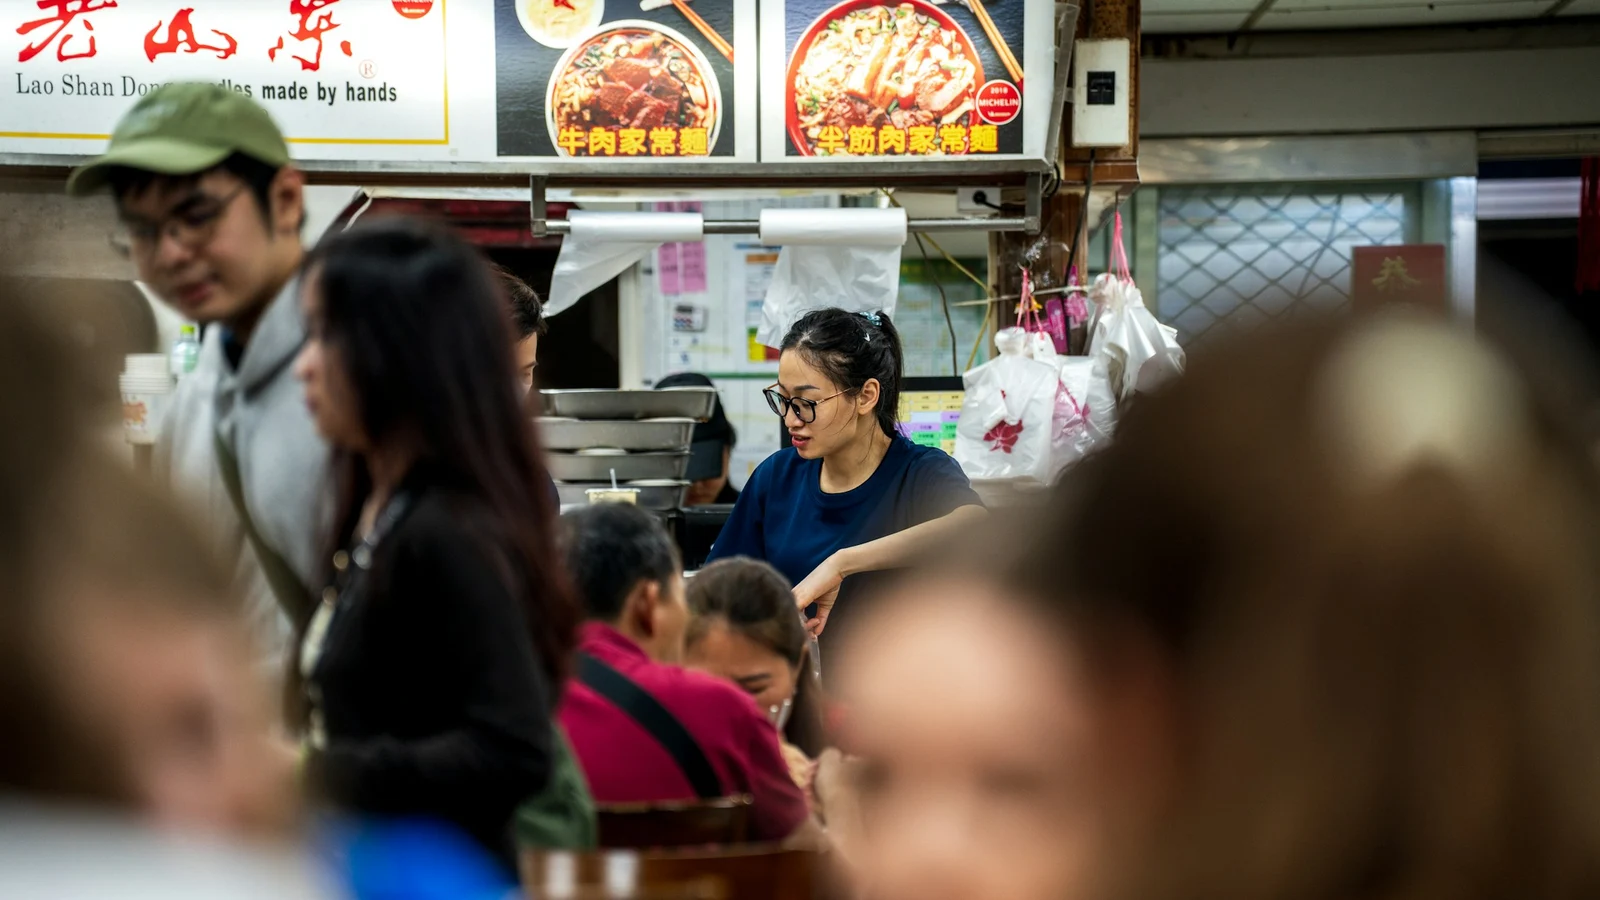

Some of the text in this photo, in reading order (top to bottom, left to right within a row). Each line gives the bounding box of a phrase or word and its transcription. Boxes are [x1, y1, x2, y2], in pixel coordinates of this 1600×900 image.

[15, 72, 54, 95] Lao
[61, 73, 115, 97] Shan
[120, 75, 173, 97] Don
[262, 80, 308, 100] made
[317, 81, 337, 106] by
[346, 80, 398, 102] hands
[978, 98, 1020, 107] MICHELIN
[558, 126, 709, 155] 牛肉家常麵
